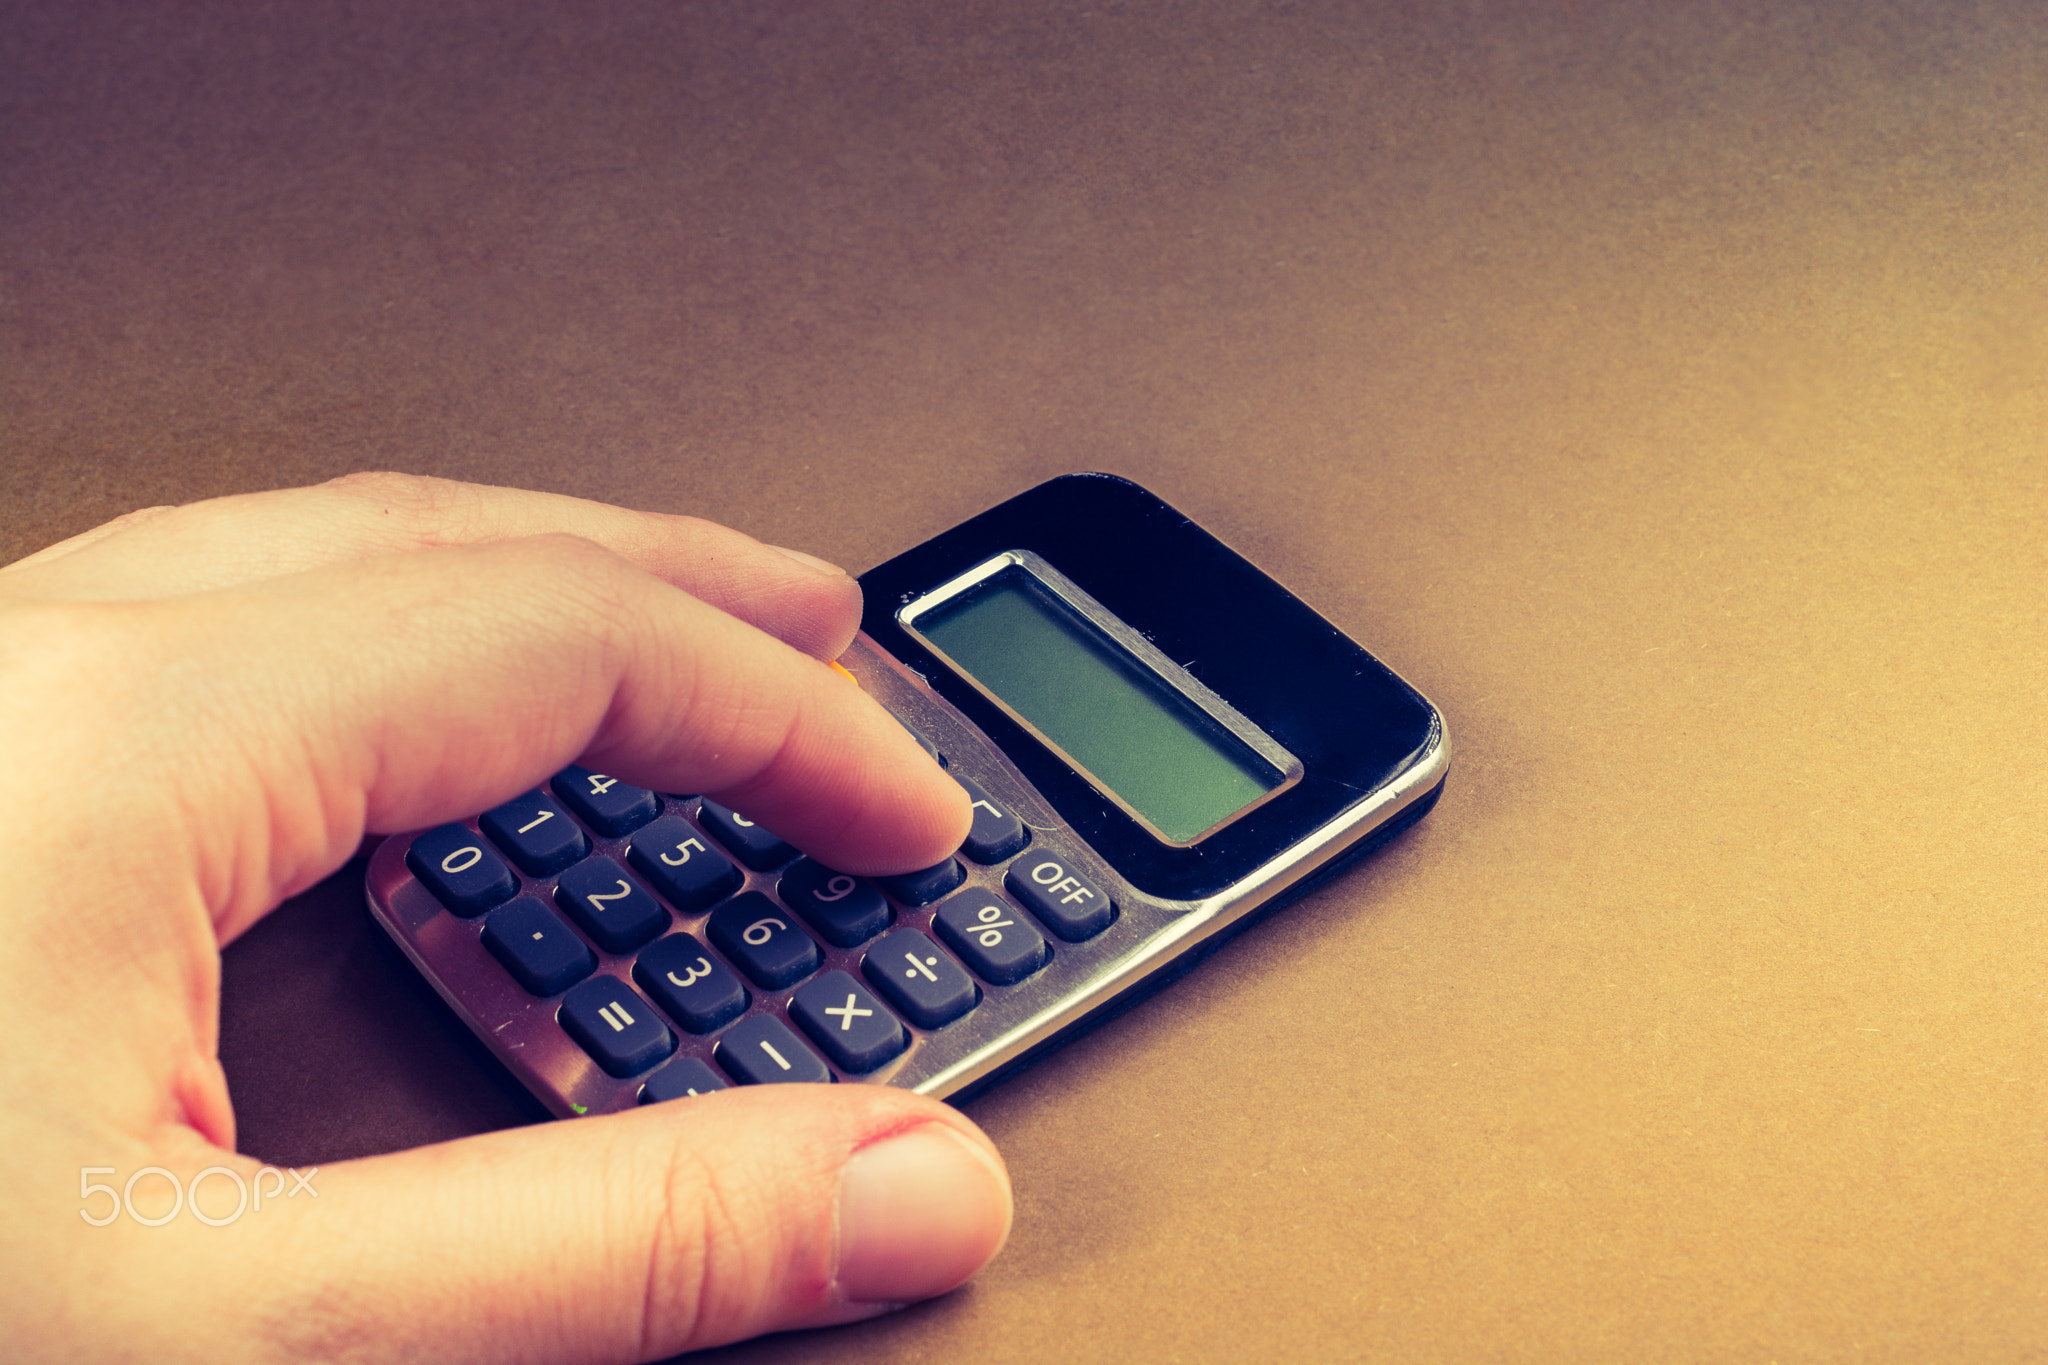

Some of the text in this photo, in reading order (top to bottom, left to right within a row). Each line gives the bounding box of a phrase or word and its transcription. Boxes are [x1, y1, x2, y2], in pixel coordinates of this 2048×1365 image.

[587, 774, 618, 795] 4
[518, 810, 555, 834] 1
[442, 847, 482, 874] 0
[661, 838, 706, 866] 5
[587, 880, 632, 912] 2
[813, 876, 856, 902] 9
[1031, 861, 1095, 905] OFF
[743, 918, 787, 946] 6
[667, 957, 712, 987] 3
